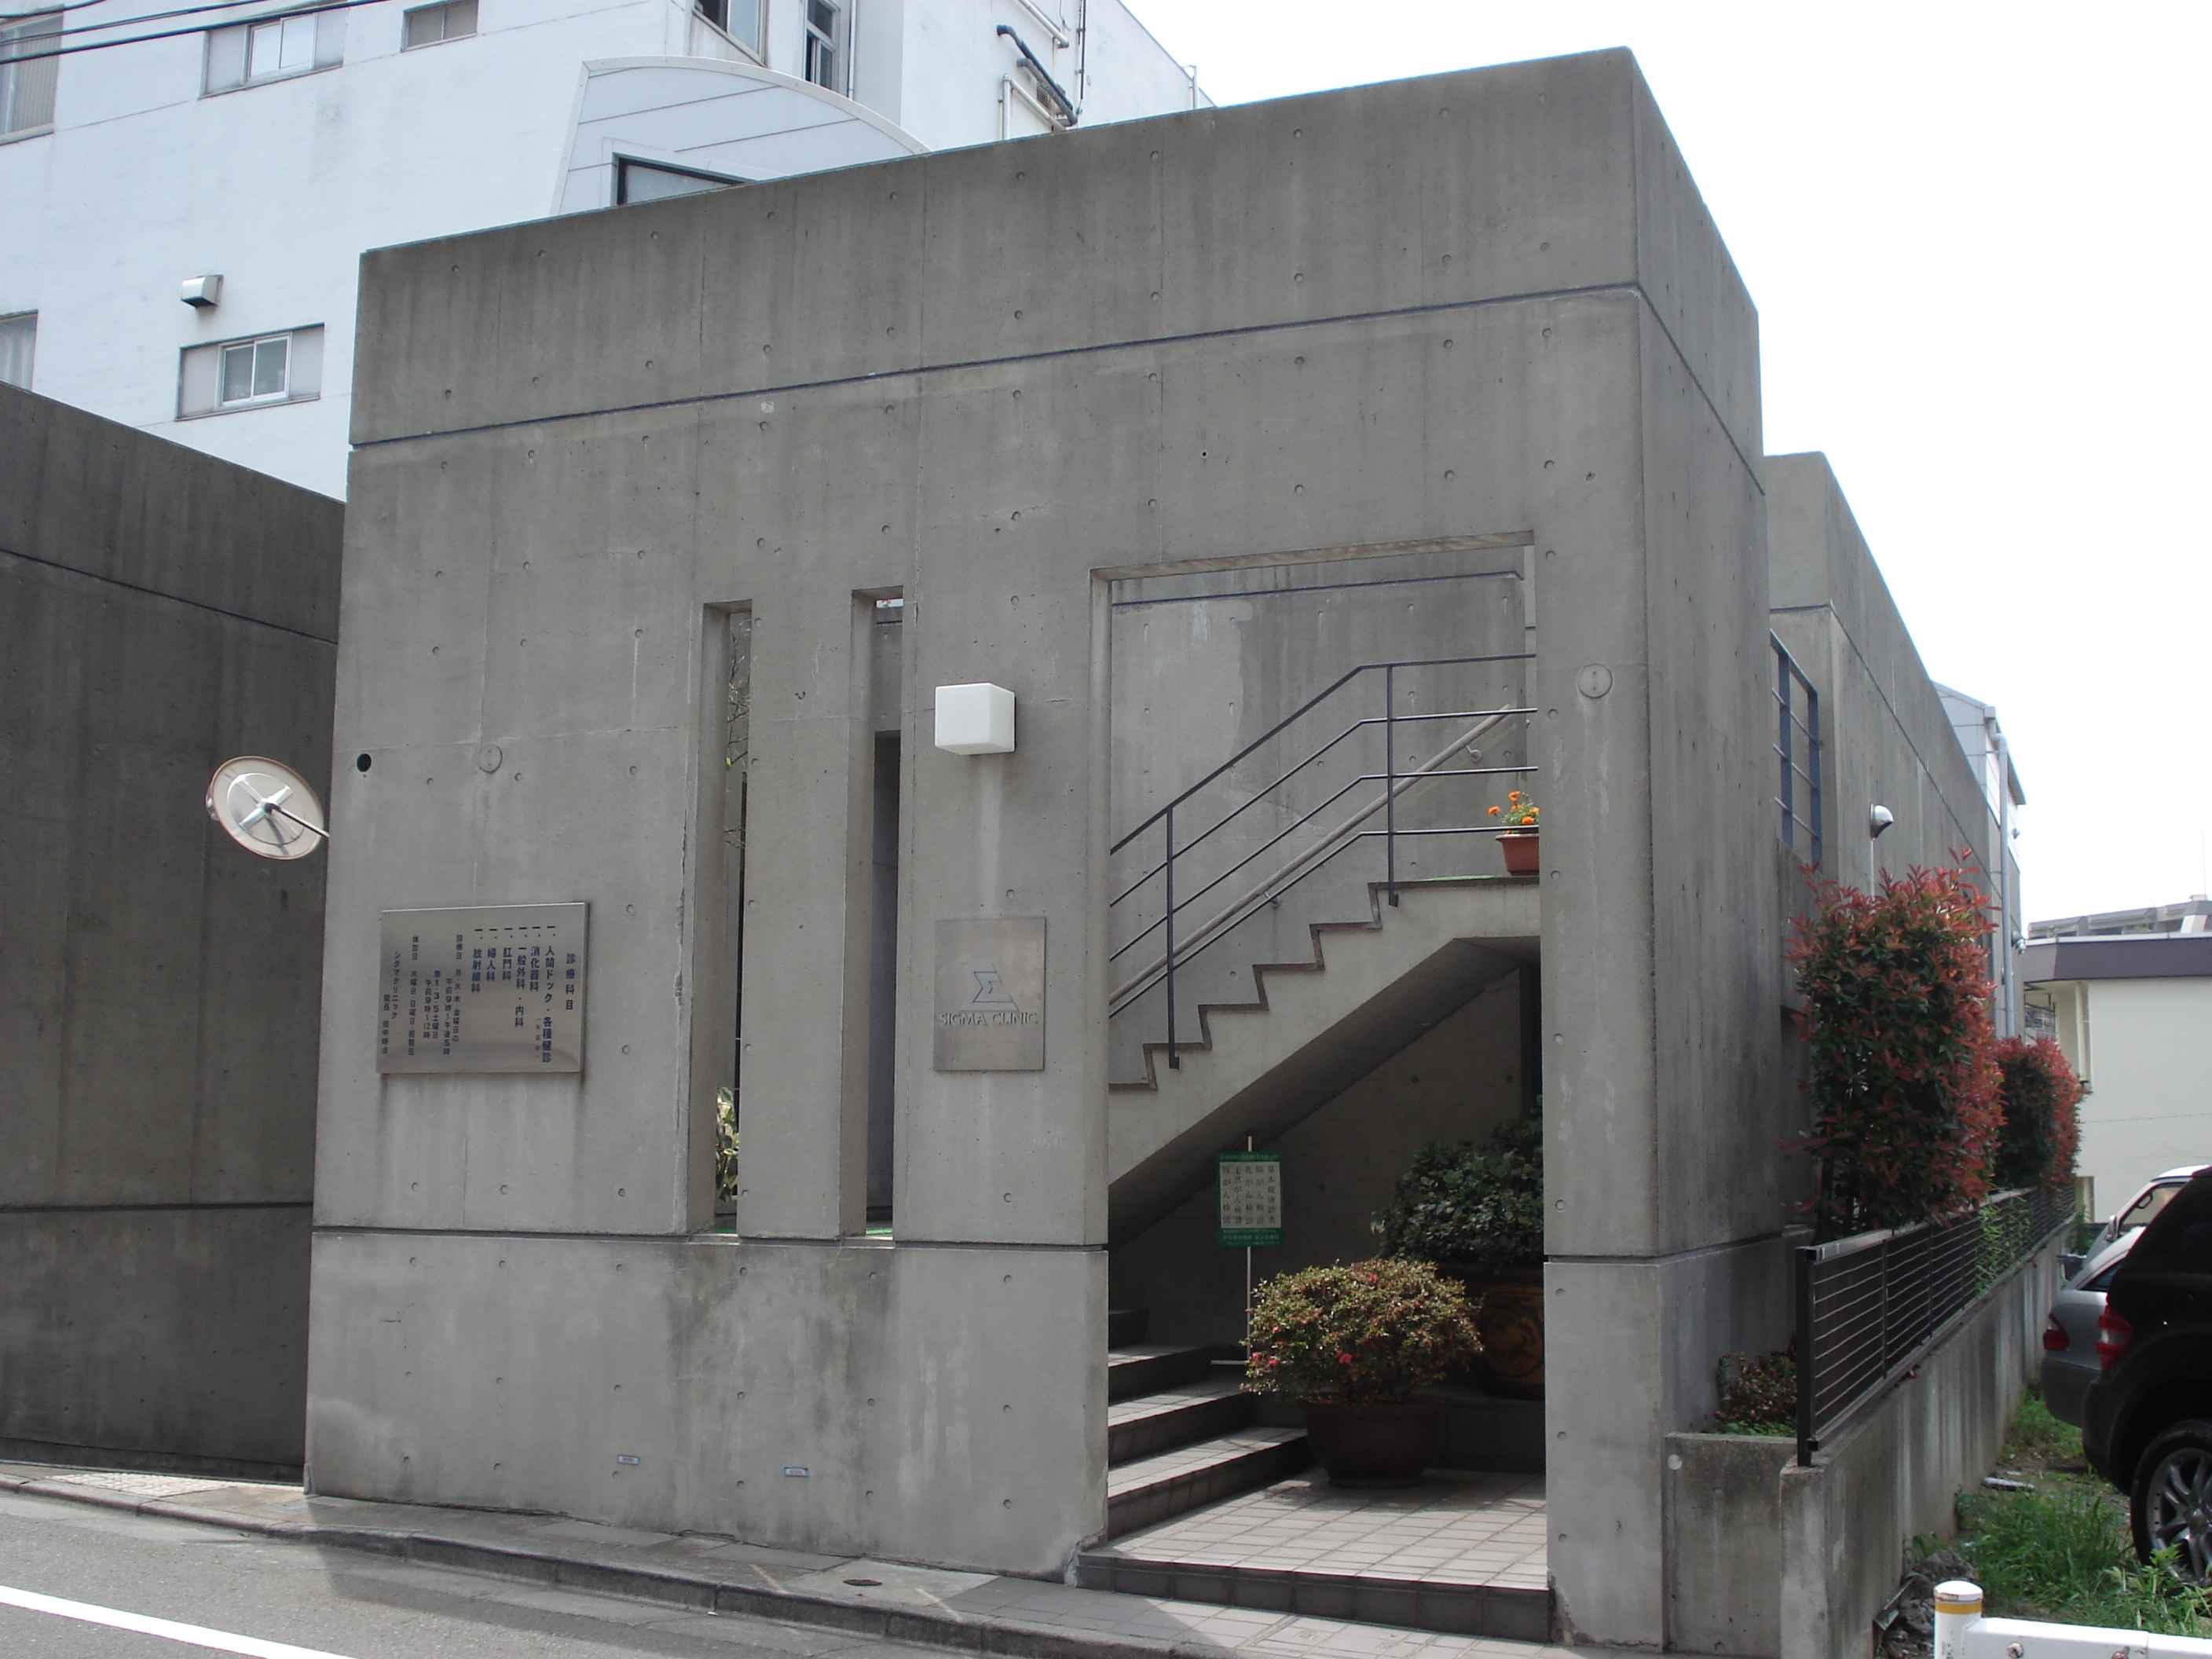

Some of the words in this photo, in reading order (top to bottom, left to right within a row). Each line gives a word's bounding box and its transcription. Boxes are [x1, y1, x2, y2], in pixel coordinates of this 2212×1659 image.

[566, 954, 576, 1010] 診療科目
[938, 1012, 987, 1026] SIGMA
[992, 1012, 1038, 1026] CLINIC
